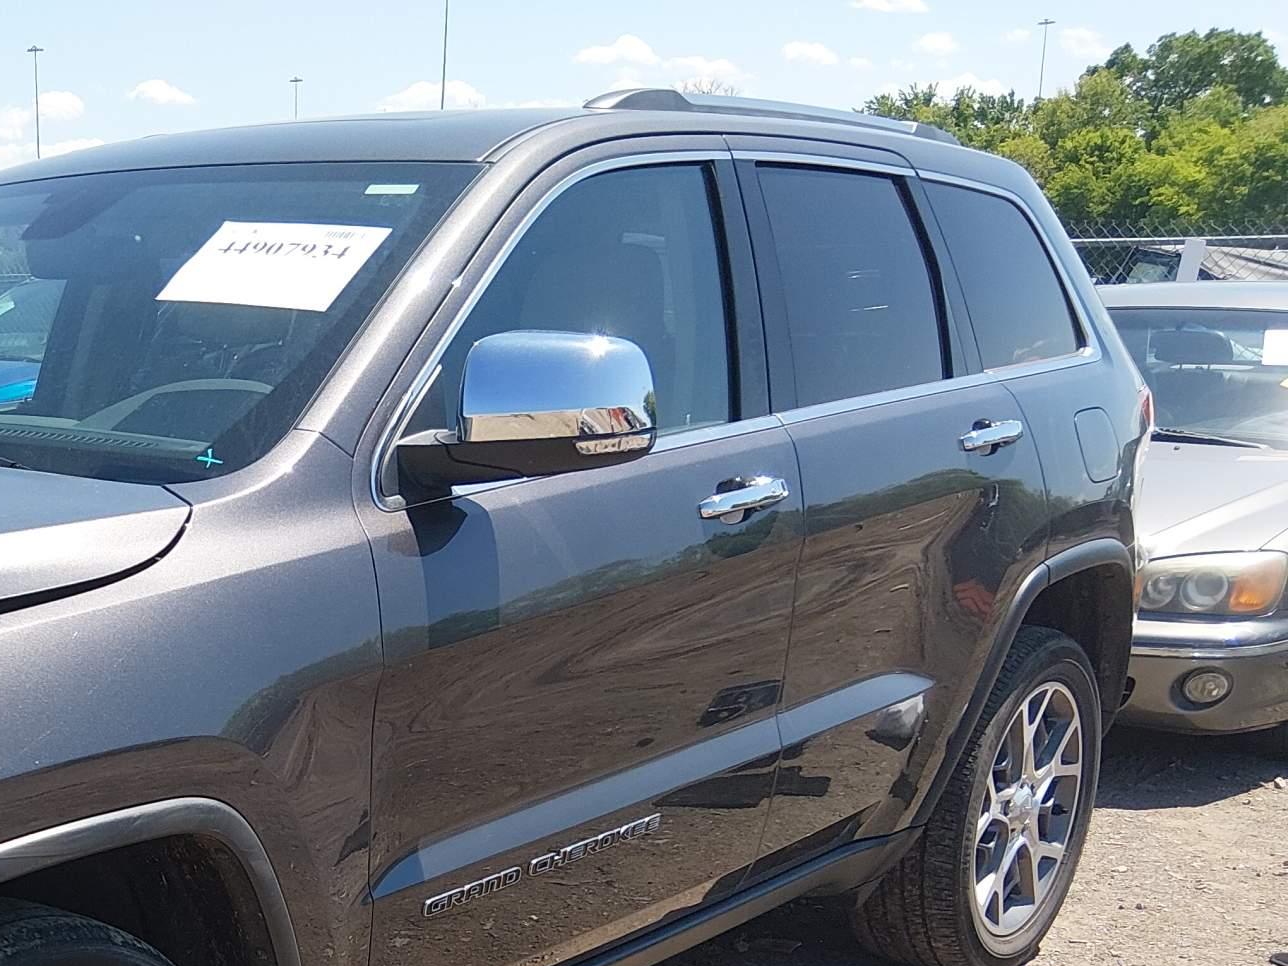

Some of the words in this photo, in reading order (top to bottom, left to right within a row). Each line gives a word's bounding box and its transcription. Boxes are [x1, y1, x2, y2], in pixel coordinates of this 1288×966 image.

[218, 240, 352, 260] 44907934
[423, 866, 523, 917] GRAND
[528, 812, 662, 877] CHEROKEE
